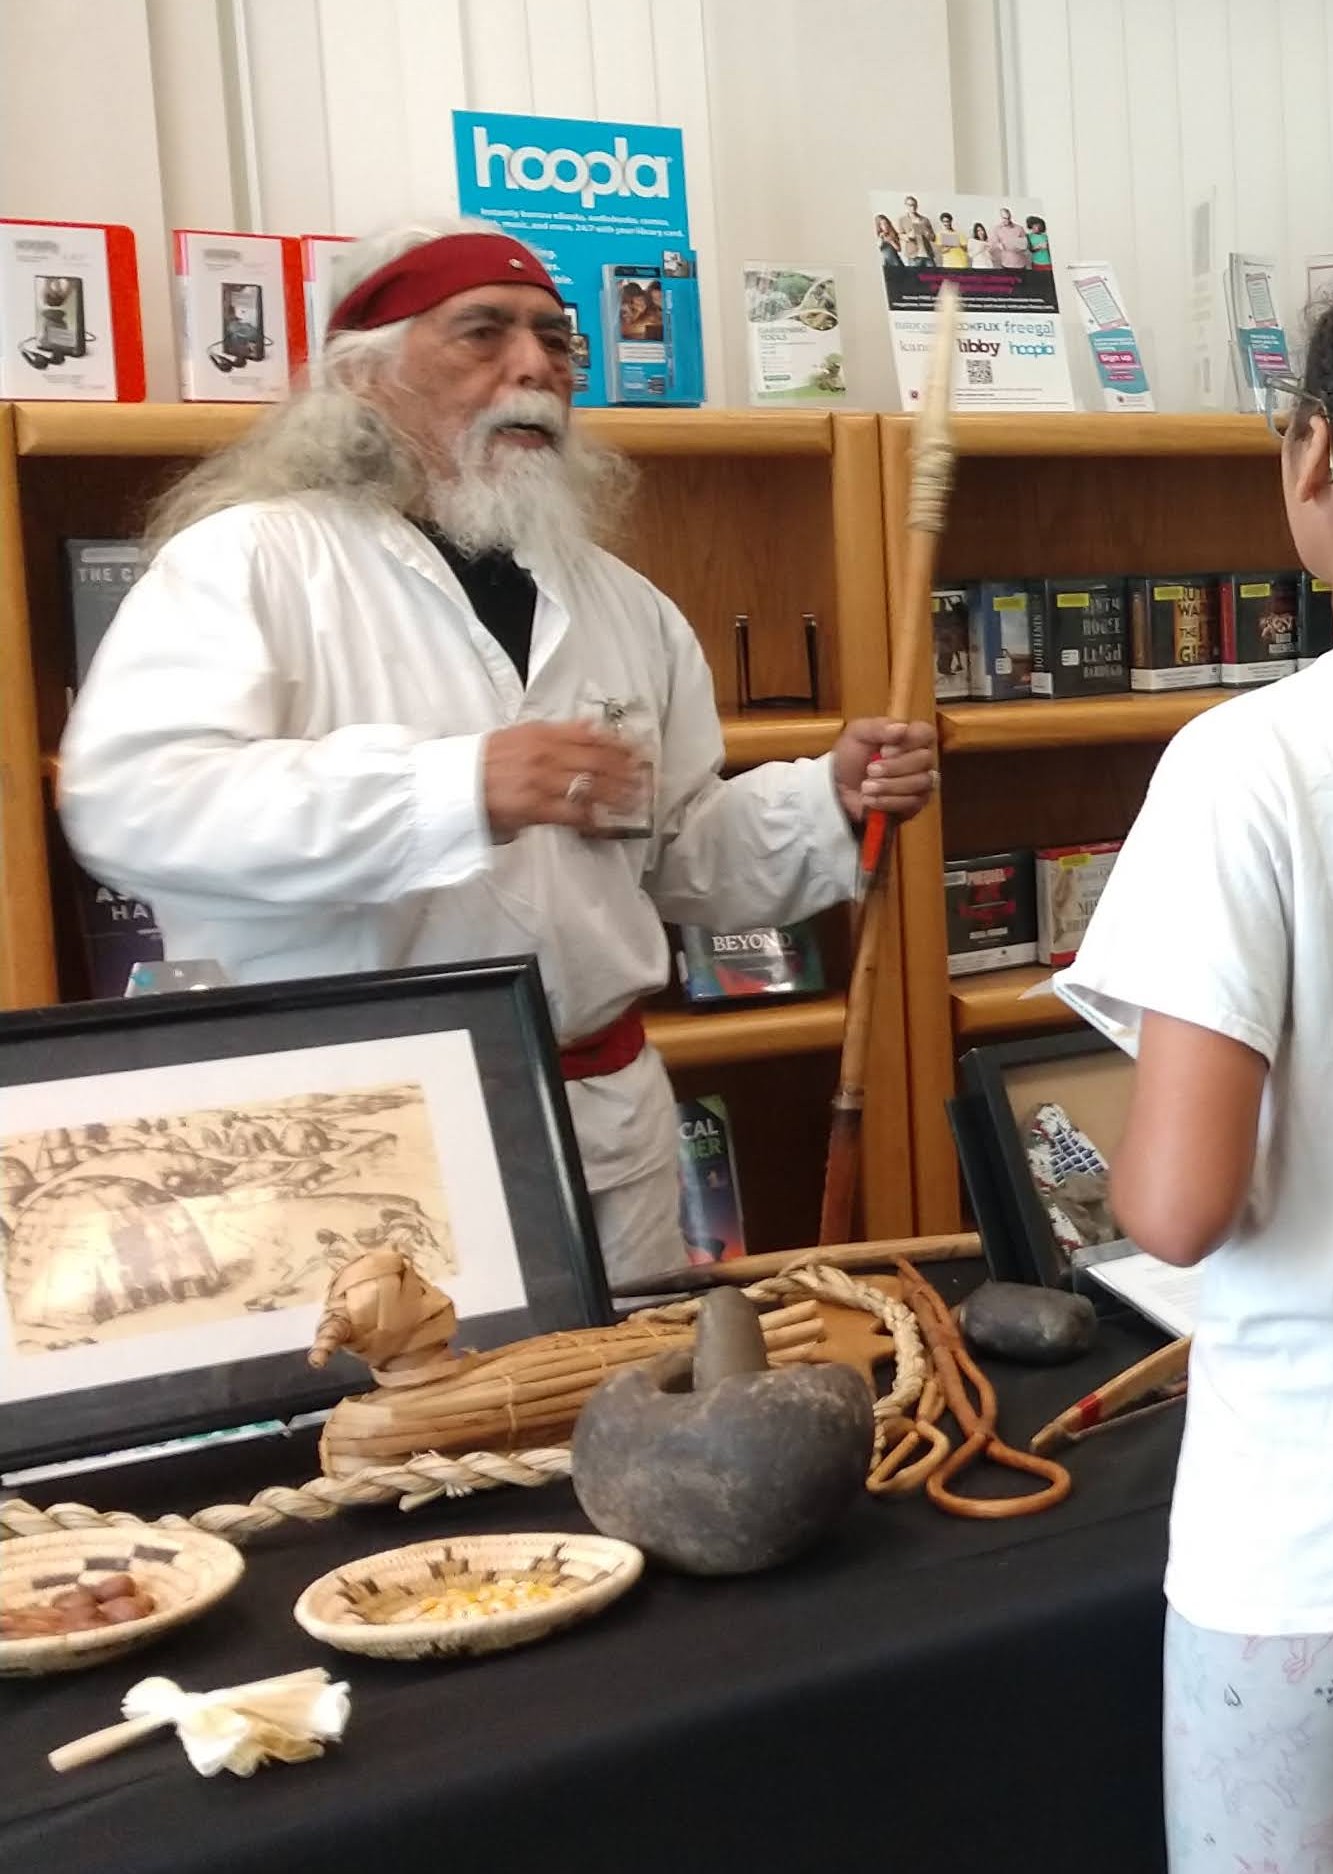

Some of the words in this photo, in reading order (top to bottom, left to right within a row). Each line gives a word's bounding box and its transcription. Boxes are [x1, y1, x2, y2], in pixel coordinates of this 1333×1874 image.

[472, 126, 670, 208] hoopla
[1004, 320, 1055, 336] freegal
[957, 339, 1000, 357] libby
[1009, 340, 1055, 358] hoopla
[77, 567, 112, 582] THE
[712, 932, 792, 951] BEYOND
[680, 1119, 720, 1139] CAL
